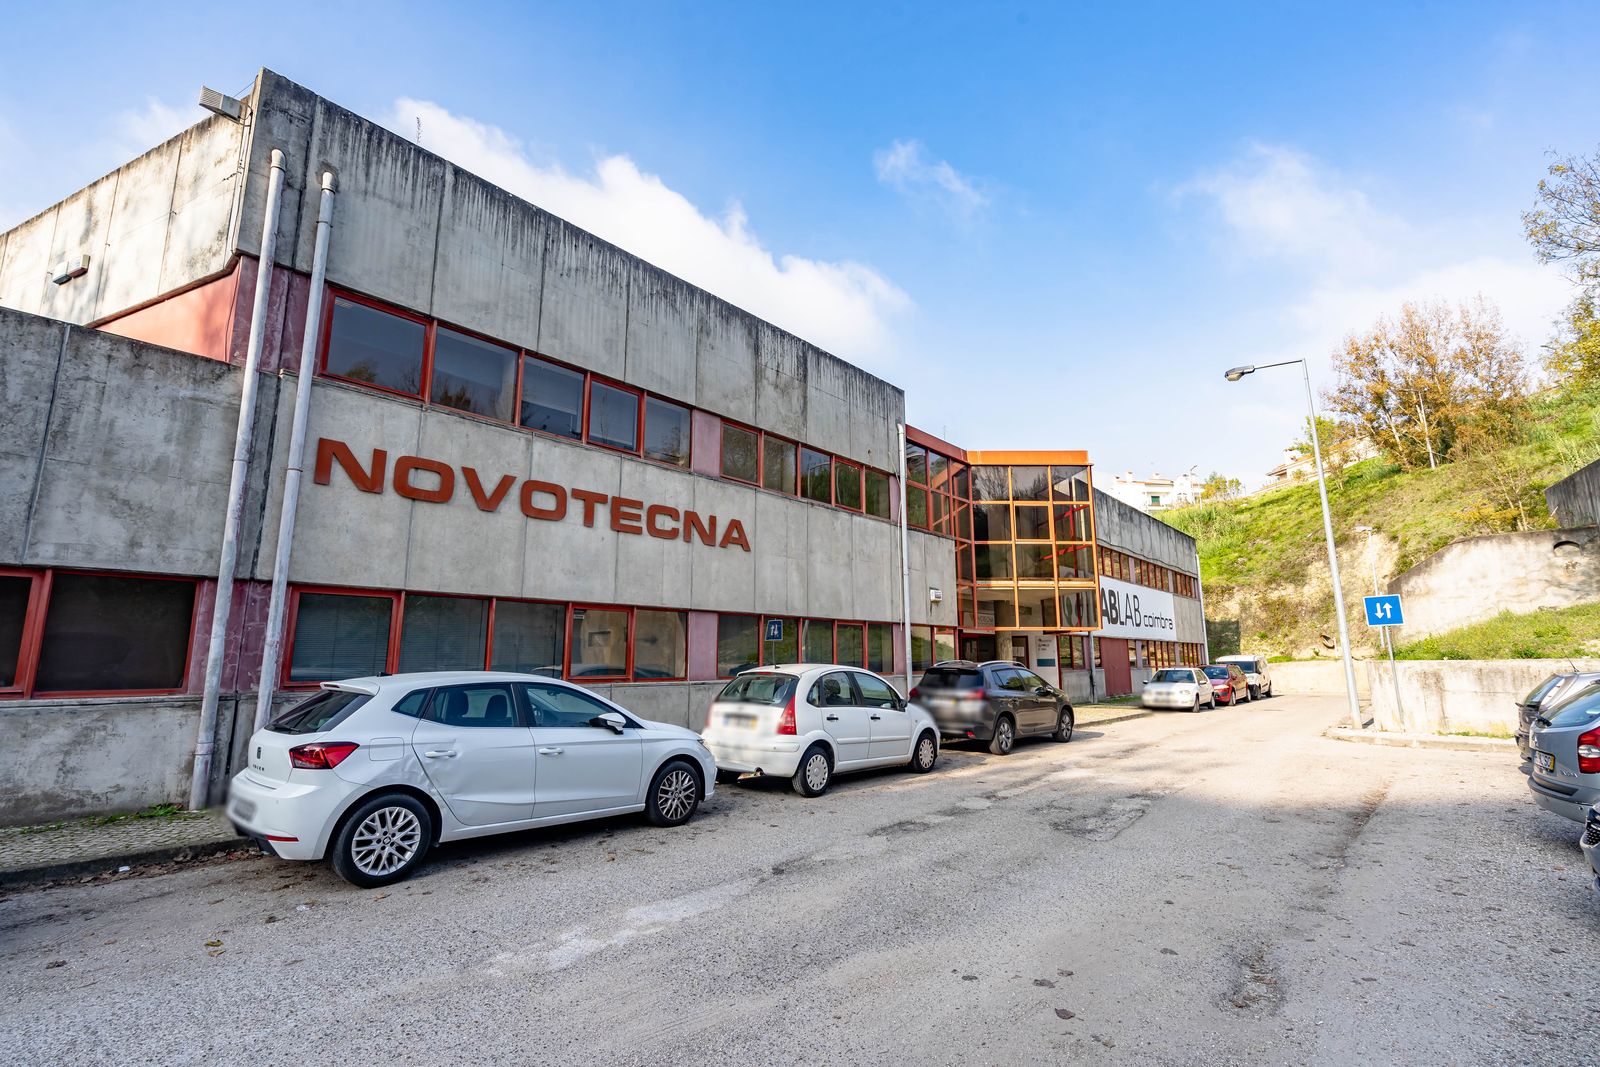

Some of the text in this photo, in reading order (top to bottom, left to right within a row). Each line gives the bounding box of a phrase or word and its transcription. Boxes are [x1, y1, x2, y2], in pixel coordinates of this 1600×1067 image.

[314, 437, 751, 552] NOVOTECNA
[1100, 587, 1174, 630] ABLAB coimbra
